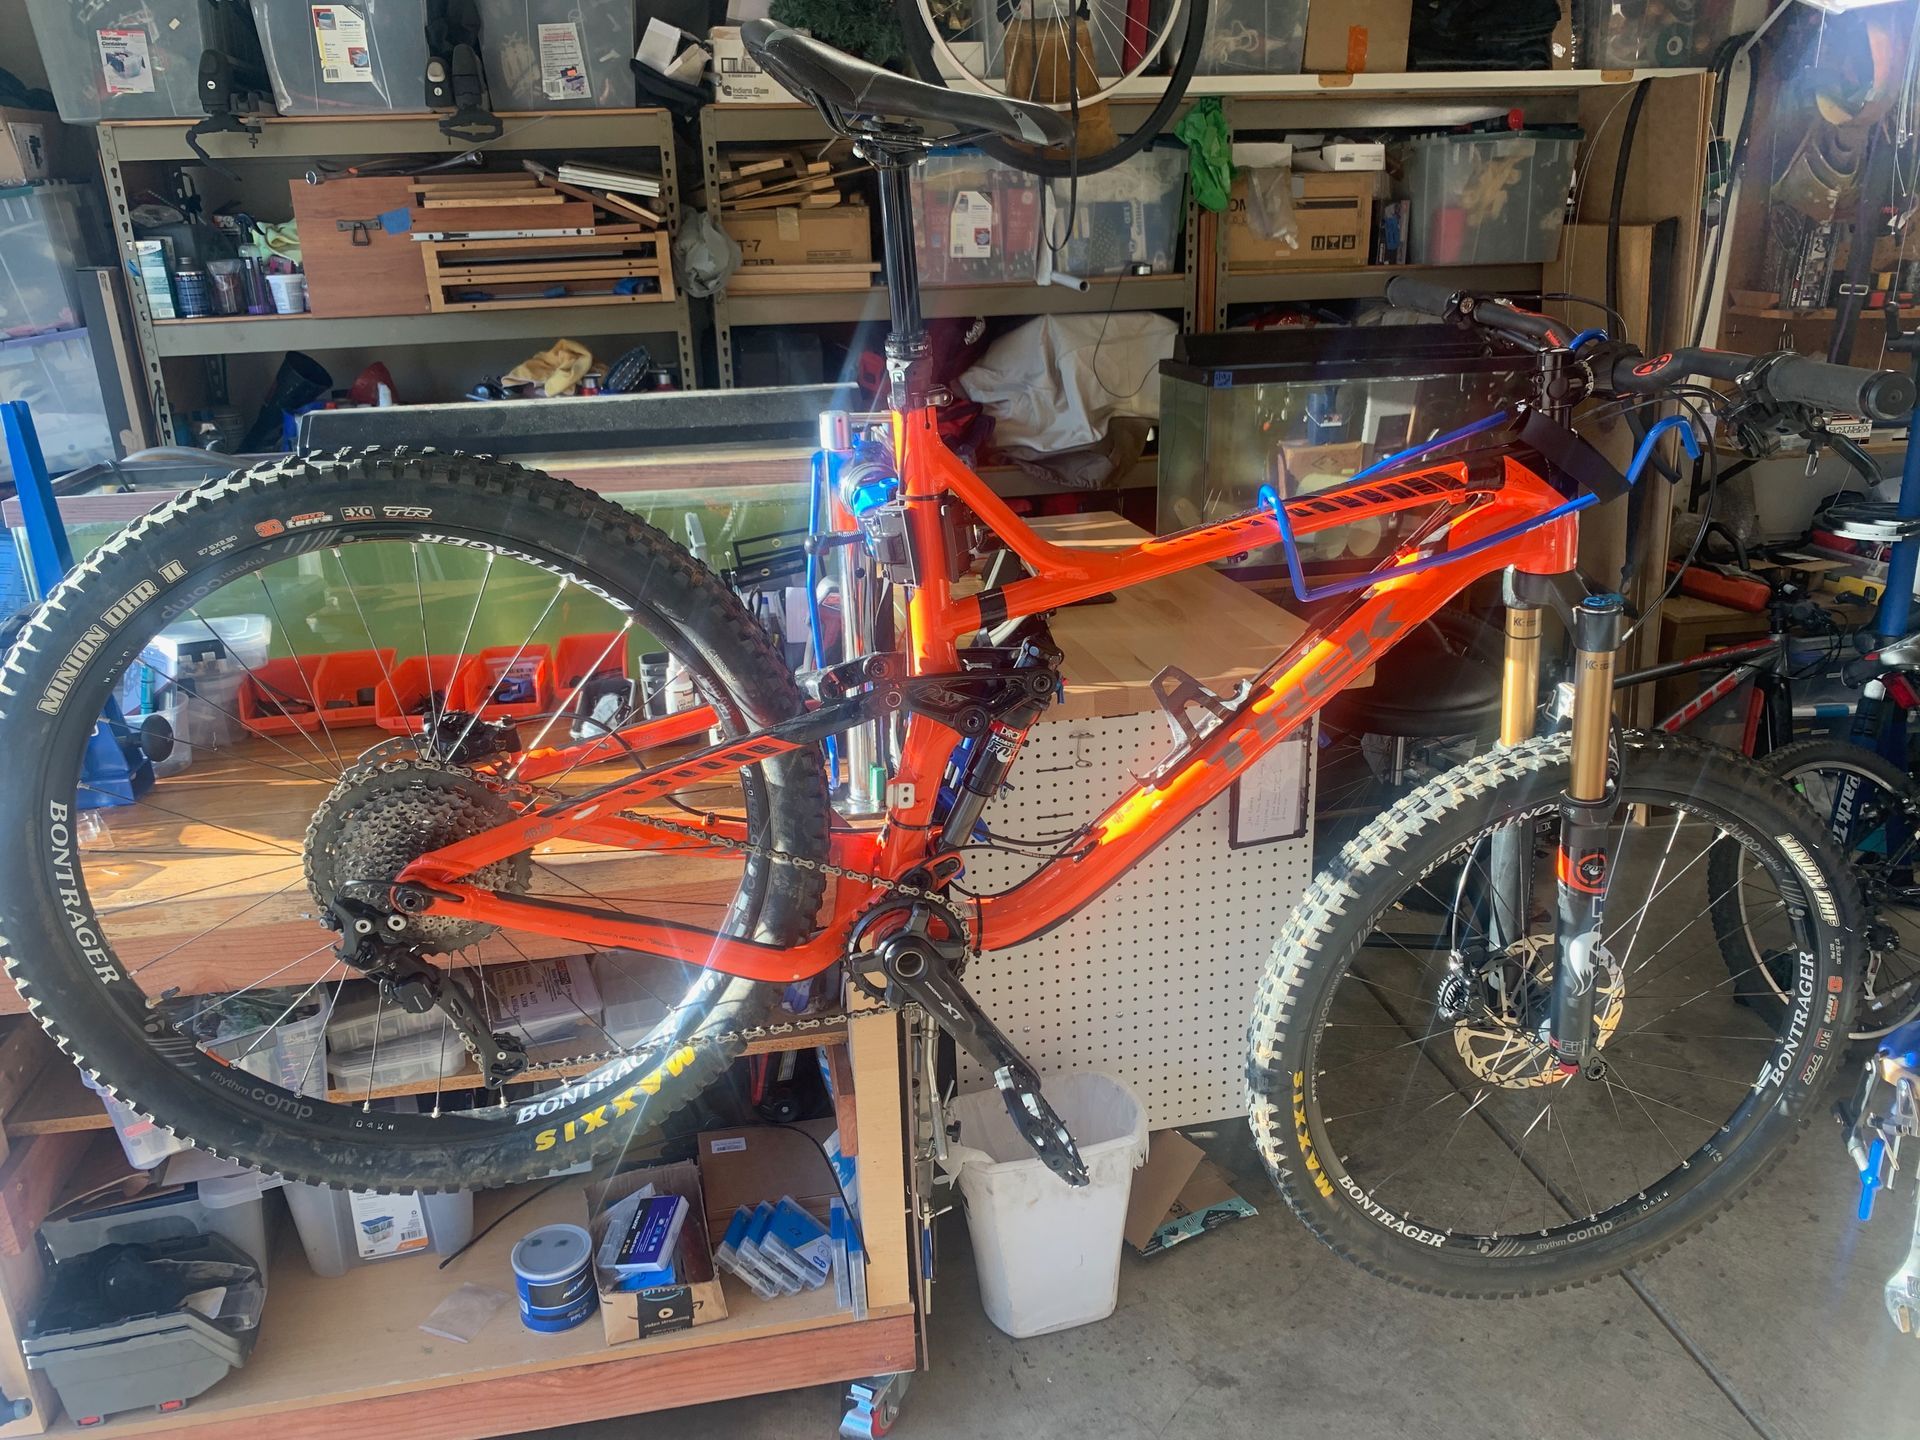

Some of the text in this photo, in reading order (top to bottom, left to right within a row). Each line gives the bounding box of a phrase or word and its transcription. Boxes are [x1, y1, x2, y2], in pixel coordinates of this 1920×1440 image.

[732, 86, 753, 94] Indiana
[342, 506, 374, 520] EXO
[382, 506, 434, 518] TR
[418, 533, 635, 612] BONTRAGER
[160, 577, 220, 620] comp
[36, 623, 110, 716] MINION
[100, 579, 160, 629] DHR
[1206, 600, 1404, 774] TREK
[1723, 822, 1762, 851] comp
[50, 799, 121, 985] BONTRAGER
[1774, 832, 1841, 928] MINION DHF
[940, 1001, 965, 1021] XT
[1769, 951, 1815, 1088] BONTRAGER
[1818, 1029, 1833, 1050] EXO
[1803, 1054, 1824, 1085] TR
[210, 1070, 313, 1119] rhythm comp
[534, 1045, 697, 1151] MAXXIS
[1293, 1070, 1335, 1198] MAXXIS
[1338, 1174, 1446, 1248] BONTRAGER
[1536, 1220, 1614, 1251] rhythm comp
